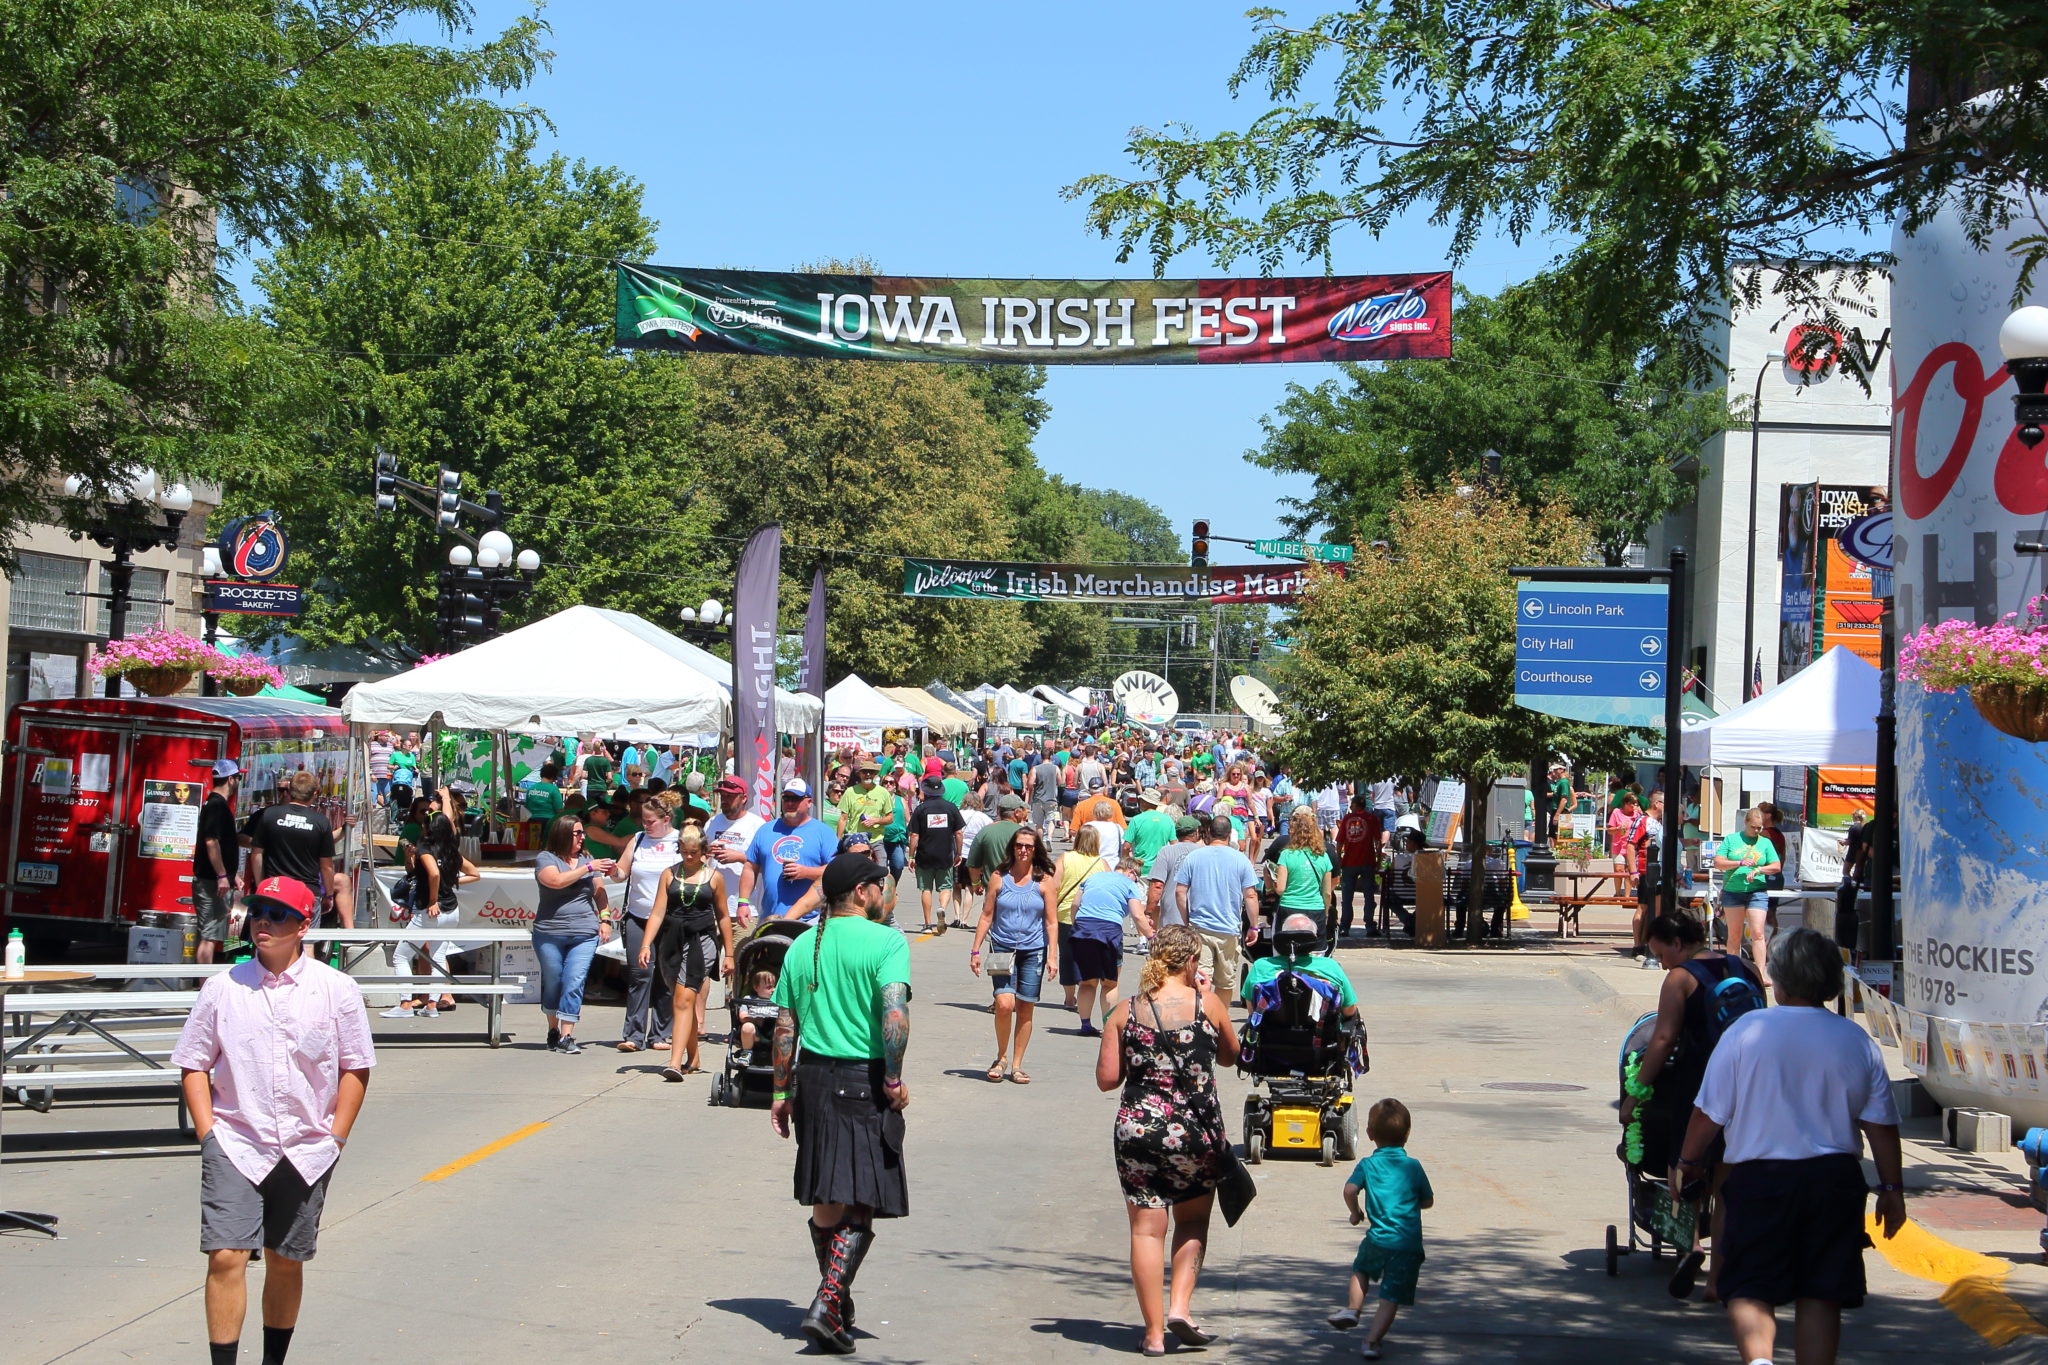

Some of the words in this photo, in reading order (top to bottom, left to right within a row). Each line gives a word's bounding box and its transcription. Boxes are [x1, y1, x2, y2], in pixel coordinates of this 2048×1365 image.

[715, 296, 750, 306] Presenting
[750, 298, 777, 306] Sponsor
[710, 305, 783, 327] Veridian
[816, 292, 968, 346] IOWA
[981, 297, 1135, 348] IRISH
[1151, 295, 1296, 347] FEST
[1329, 289, 1421, 337] Nagle
[640, 321, 659, 333] IOWA
[659, 319, 676, 329] IRISH
[677, 321, 694, 333] FEST
[1389, 322, 1413, 332] signs
[1821, 490, 1860, 506] IOWA
[1829, 501, 1869, 517] IRISH
[1819, 514, 1855, 528] FEST
[1259, 541, 1325, 558] MULBERRY
[1332, 546, 1348, 559] ST
[914, 565, 998, 594] Welcome
[1006, 571, 1068, 595] Irish
[1074, 572, 1237, 596] Merchandise
[1242, 571, 1331, 596] Mark
[219, 587, 297, 601] ROCKETS
[971, 583, 981, 592] to
[982, 583, 999, 593] the
[242, 600, 274, 610] BAKERY
[1549, 603, 1592, 616] Lincoln
[1596, 604, 1625, 616] Park
[1521, 637, 1546, 652] City
[1549, 637, 1574, 651] Hall
[1520, 670, 1593, 684] Courthouse
[1115, 673, 1173, 707] KWWL
[829, 741, 862, 751] PIZZA
[753, 733, 775, 823] oors
[146, 789, 171, 797] GUINNESS
[1824, 784, 1845, 792] office
[41, 795, 99, 807] 319-88-3377
[276, 819, 313, 831] CAPTAIN
[285, 813, 307, 823] BEER
[147, 835, 163, 843] ONE
[165, 836, 189, 844] TOKEN
[478, 900, 537, 919] Coors
[1907, 940, 1923, 965] THE
[1927, 937, 2035, 976] ROCKIES
